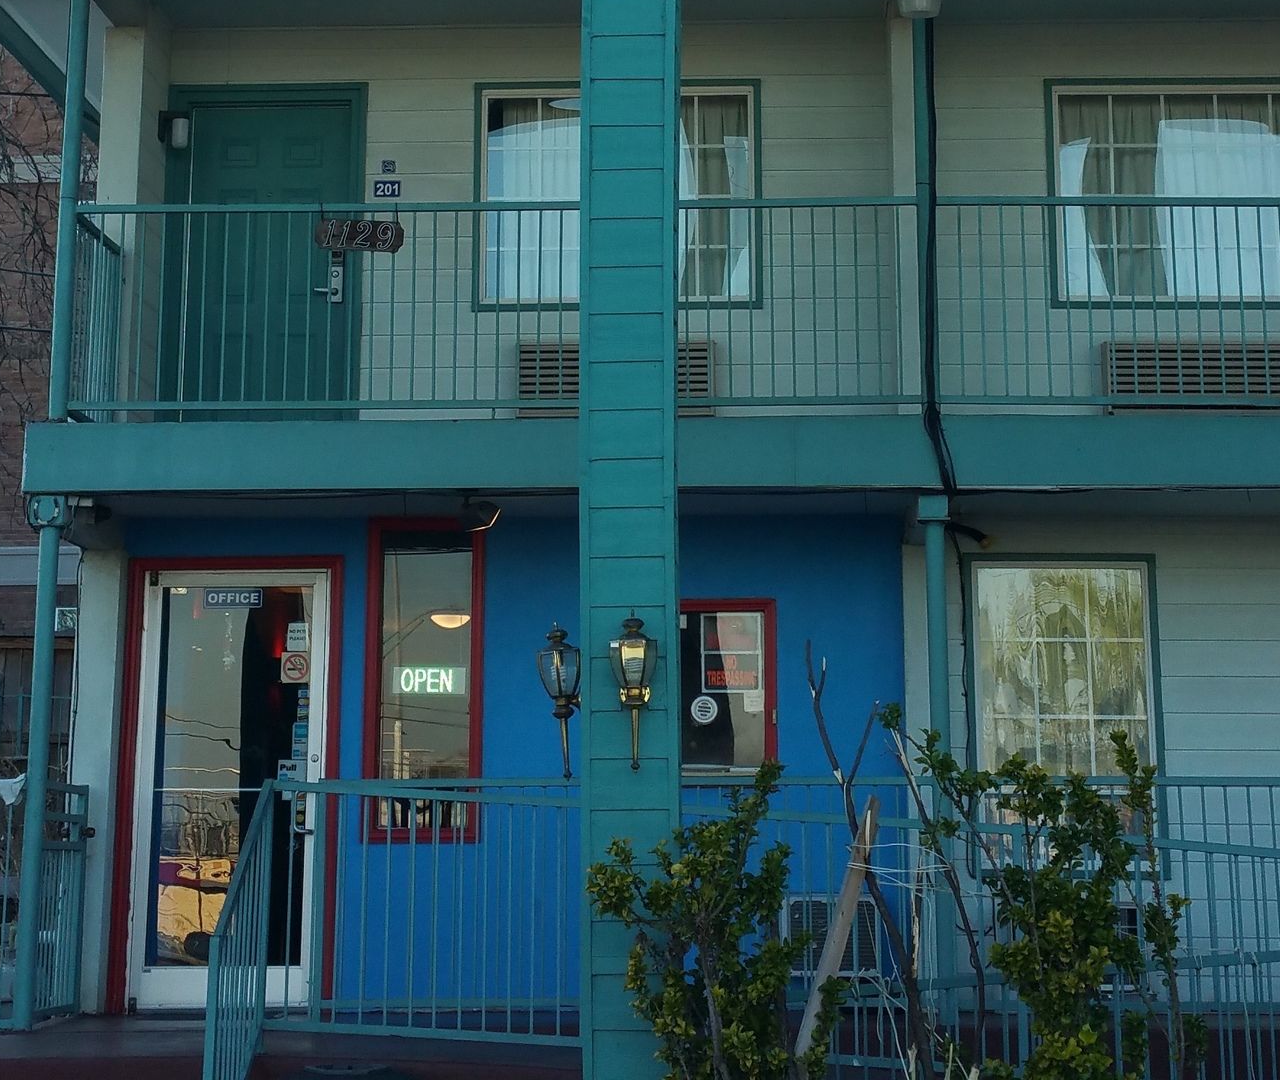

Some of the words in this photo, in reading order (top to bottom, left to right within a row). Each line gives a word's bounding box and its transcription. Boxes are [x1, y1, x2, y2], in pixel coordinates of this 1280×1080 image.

[375, 183, 400, 196] 201
[322, 219, 396, 250] 1129
[207, 592, 260, 604] OFFICE
[400, 668, 453, 693] OPEN
[279, 763, 297, 772] Pull
